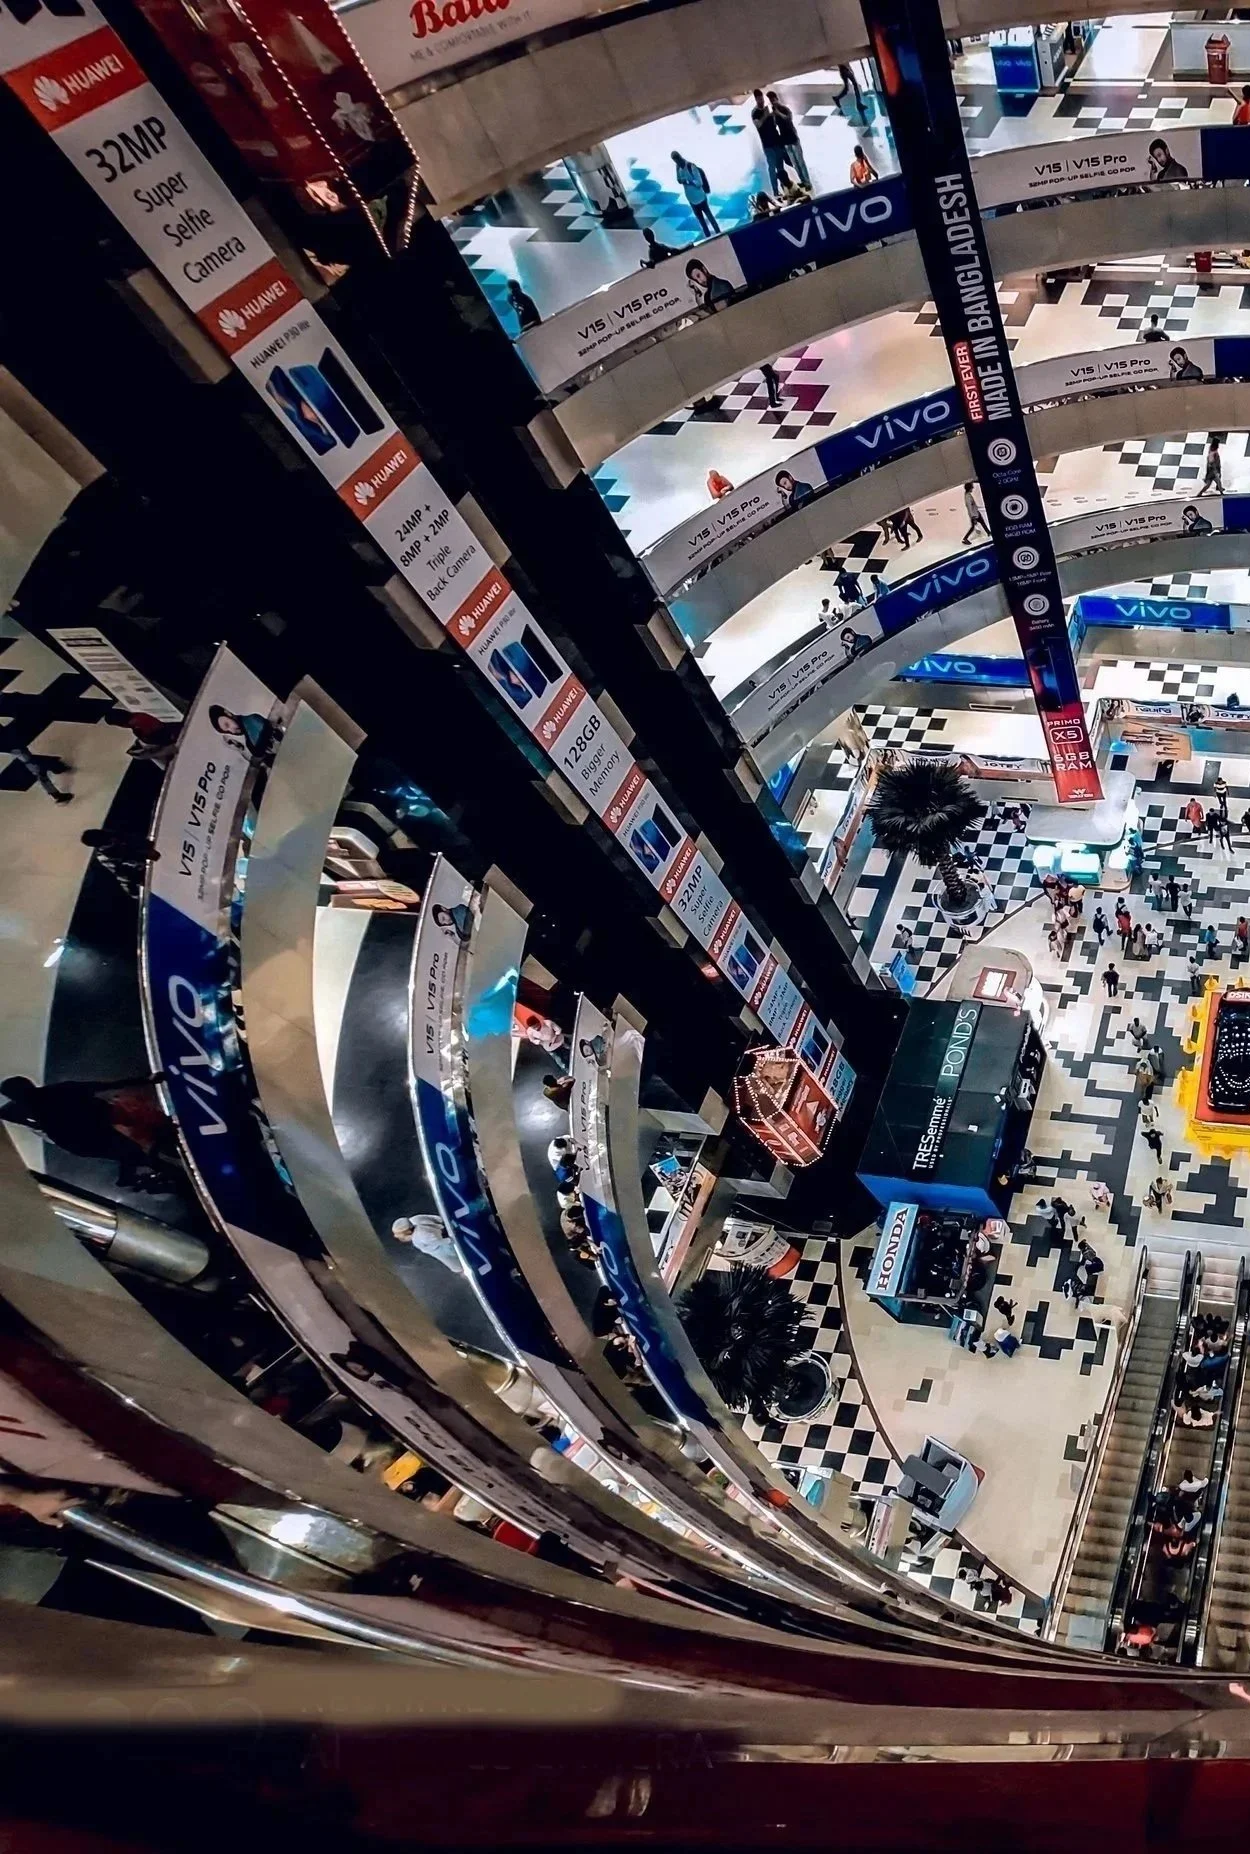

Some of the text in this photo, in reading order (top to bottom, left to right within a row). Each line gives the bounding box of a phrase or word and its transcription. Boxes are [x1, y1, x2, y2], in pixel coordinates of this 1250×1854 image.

[63, 53, 124, 95] HUAWEI
[85, 115, 168, 183] 32MP
[1034, 154, 1127, 176] V15 V15 Pro
[133, 171, 189, 214] Super
[163, 207, 215, 247] Selfie
[778, 195, 894, 249] vivo
[182, 235, 246, 284] Camera
[240, 280, 287, 320] HUAWEI
[577, 287, 668, 340] V15 V15 Pro
[935, 173, 1012, 421] MADE IN BANGLADESH
[250, 337, 287, 370] HUAWEI
[1071, 366, 1094, 377] V15
[1104, 361, 1128, 371] V15
[1130, 359, 1151, 367] Pro
[955, 345, 984, 421] FIRST EVER
[854, 399, 951, 449] vivo
[370, 449, 408, 489] HUAWEI
[394, 509, 422, 542] 24MP
[400, 541, 422, 568] 8MP
[428, 508, 451, 536] 2MP
[688, 496, 761, 547] V15 V15 Pro
[426, 545, 452, 572] Triple
[426, 544, 476, 602] Back Camera
[907, 557, 991, 602] vivo
[473, 582, 502, 620] HUAWEI
[1115, 600, 1192, 621] vivo
[768, 651, 828, 699] V15 V15 Pro
[553, 687, 579, 724] HUAWEI
[1047, 718, 1081, 726] PRIMO
[564, 714, 601, 770] 128GB
[1053, 751, 1090, 762] 6GB
[1054, 730, 1078, 741] X5
[581, 743, 606, 780] Bigger
[589, 750, 620, 797] Memory
[1056, 760, 1093, 771] RAM
[619, 774, 640, 808] HUAWEI
[178, 840, 196, 877] V15
[188, 791, 206, 827] V15
[198, 761, 217, 793] Pro
[674, 847, 692, 879] HUAWEI
[678, 864, 703, 912] 32MP
[690, 886, 708, 915] Super
[698, 895, 714, 924] Selfie
[703, 900, 724, 938] Camera
[720, 909, 736, 940] HUAWEI
[426, 953, 439, 1054] V15 V15 Pro
[794, 1009, 808, 1038] HUAWEI
[167, 973, 227, 1137] vivo
[941, 1008, 978, 1077] POND'S
[912, 1096, 946, 1170] TRESemmé
[434, 1140, 493, 1276] vivo
[876, 1208, 909, 1290] HONDA
